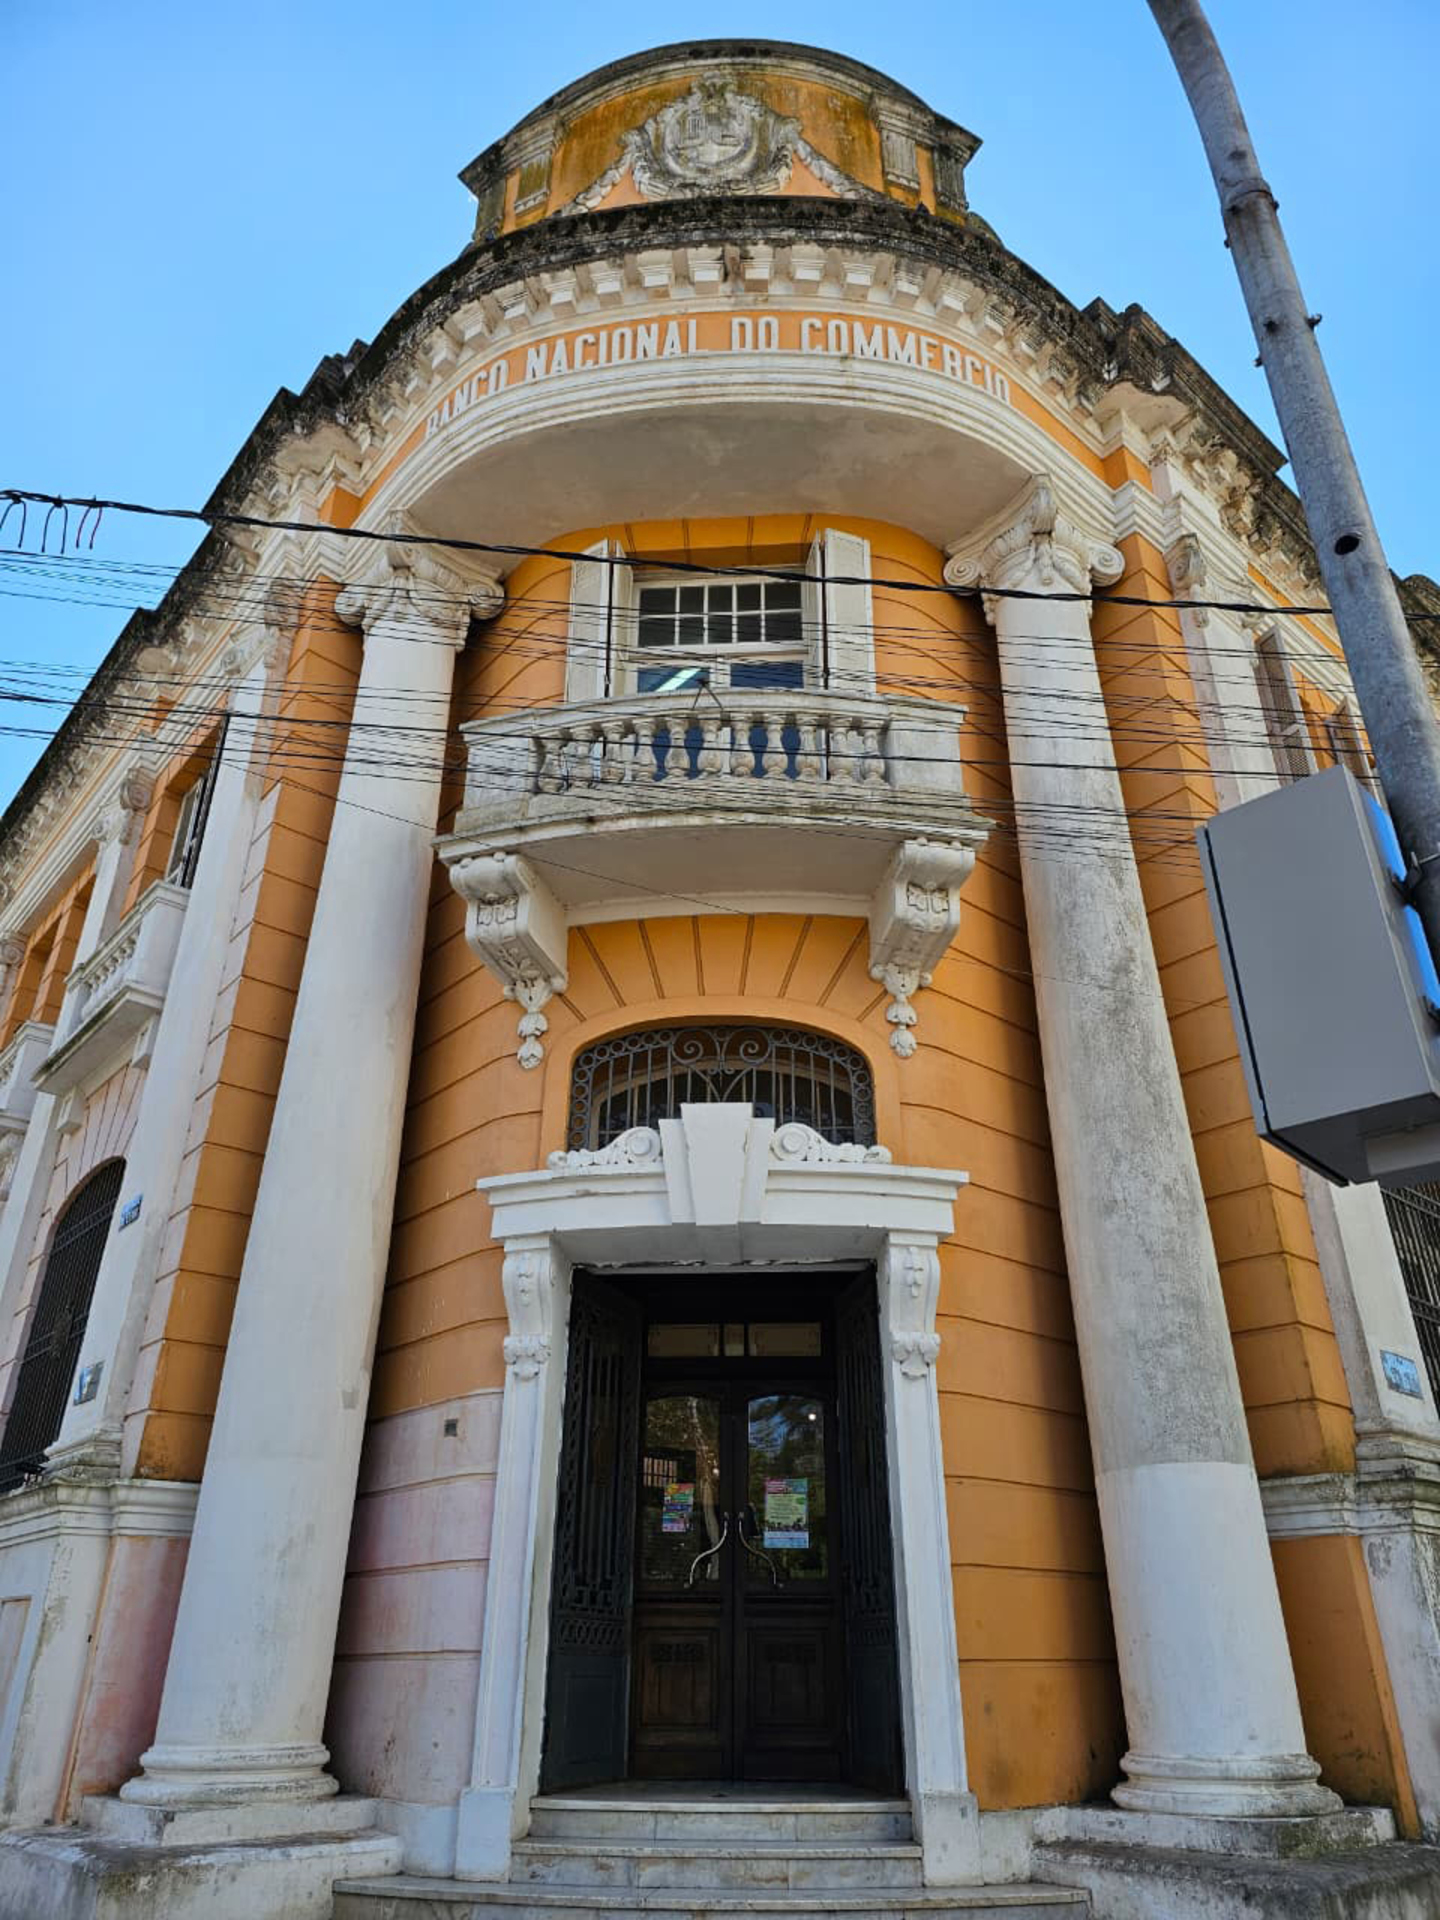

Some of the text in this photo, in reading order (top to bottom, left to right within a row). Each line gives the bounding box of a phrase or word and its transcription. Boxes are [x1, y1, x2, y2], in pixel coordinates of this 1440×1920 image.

[525, 319, 708, 386] NACIONAL
[731, 316, 779, 353] DO
[801, 317, 1011, 406] COMMERCIO
